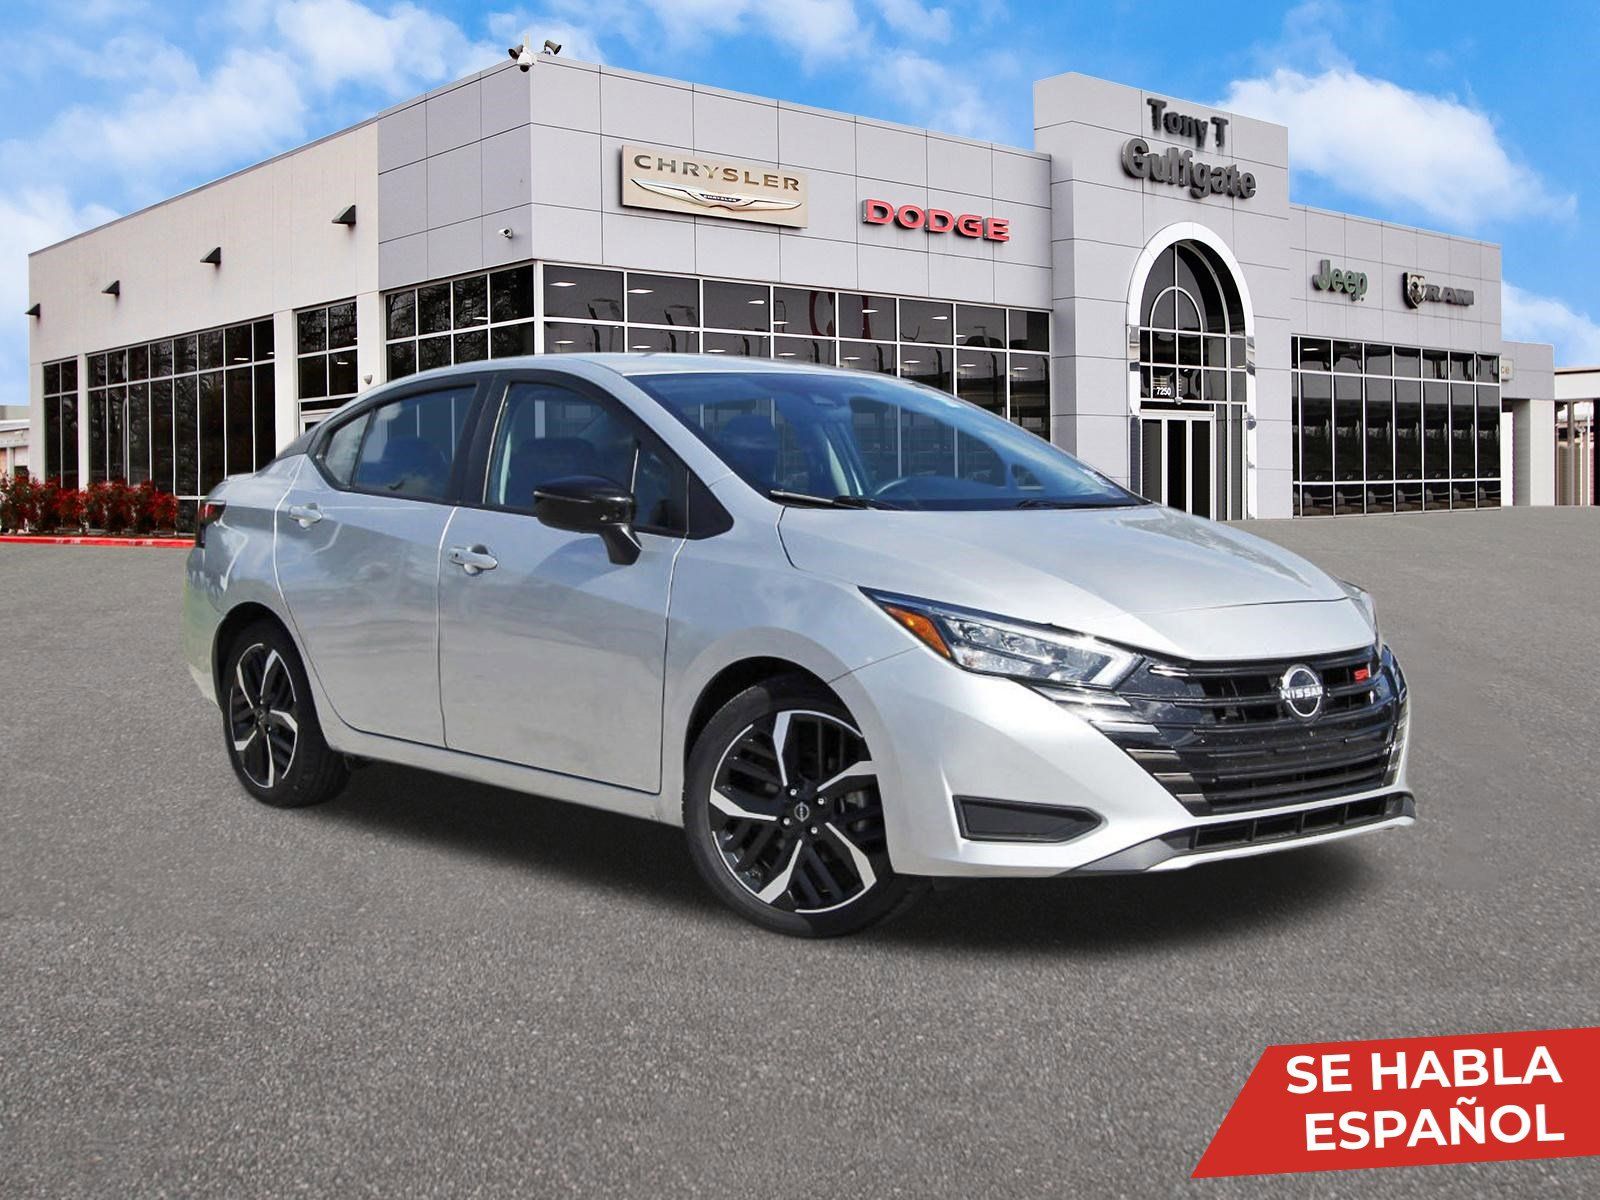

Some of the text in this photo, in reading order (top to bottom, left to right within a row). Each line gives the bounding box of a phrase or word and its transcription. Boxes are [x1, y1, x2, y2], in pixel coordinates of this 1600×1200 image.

[1146, 98, 1229, 147] Tony T
[633, 153, 800, 191] CHRYSLER
[1121, 138, 1256, 199] Gulfgate
[862, 199, 1010, 242] DODGE
[1312, 259, 1367, 302] Jeep
[1425, 284, 1475, 306] RAM
[1156, 387, 1172, 396] 7250
[1280, 686, 1323, 699] NISSAN
